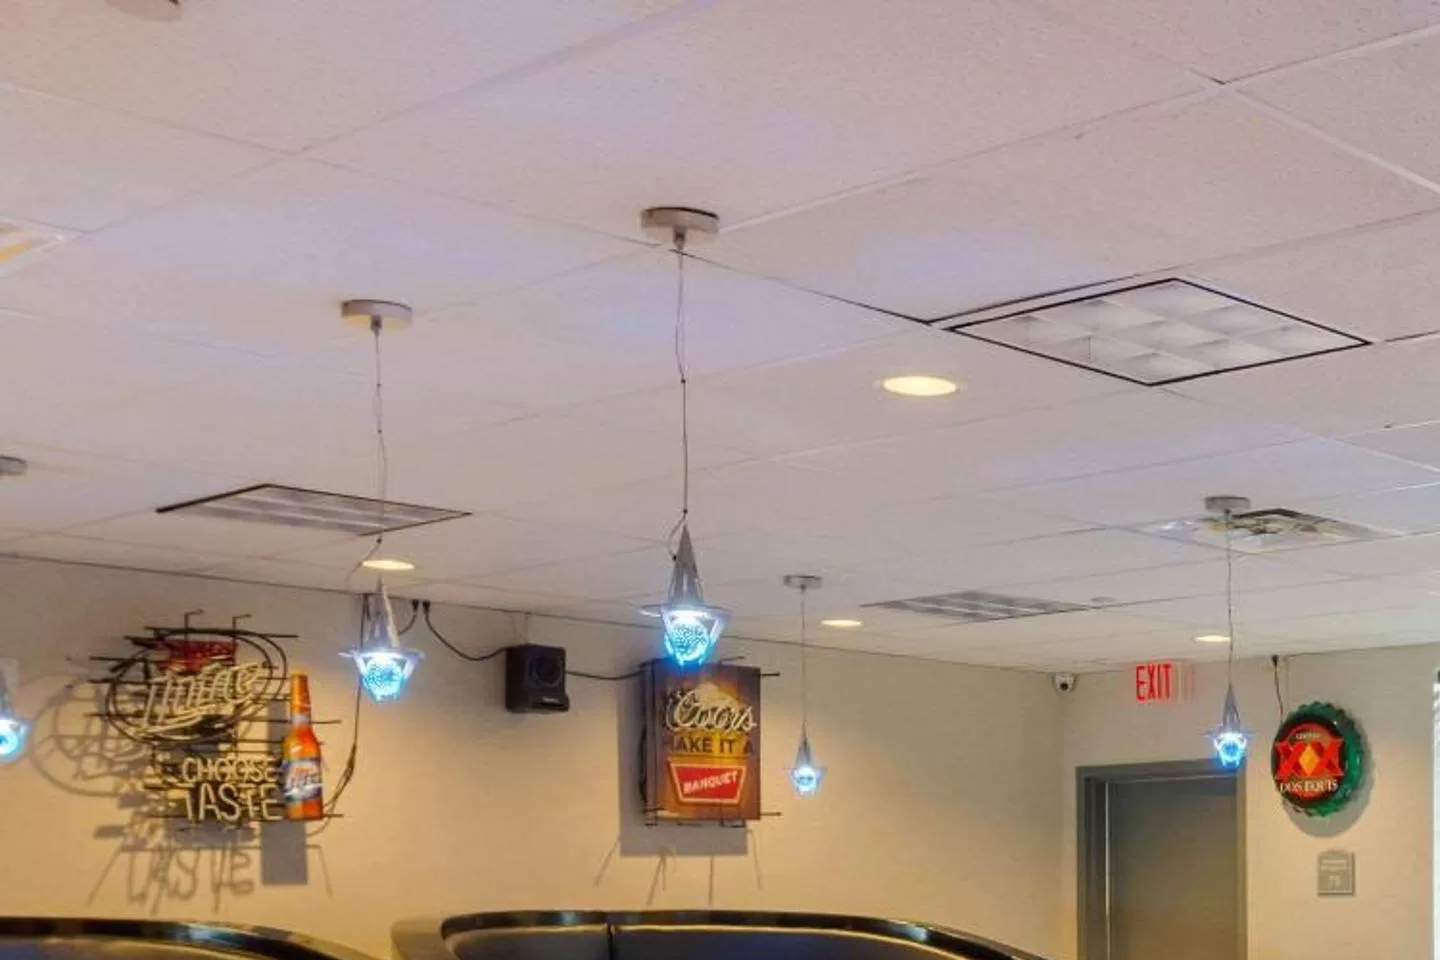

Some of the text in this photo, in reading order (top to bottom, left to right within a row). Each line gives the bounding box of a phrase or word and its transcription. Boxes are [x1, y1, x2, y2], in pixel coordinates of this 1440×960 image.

[1136, 663, 1172, 700] EXIT
[665, 688, 758, 735] Coors
[181, 757, 279, 783] CHOOSE
[683, 769, 738, 795] BANQUET
[175, 782, 283, 821] TASTE
